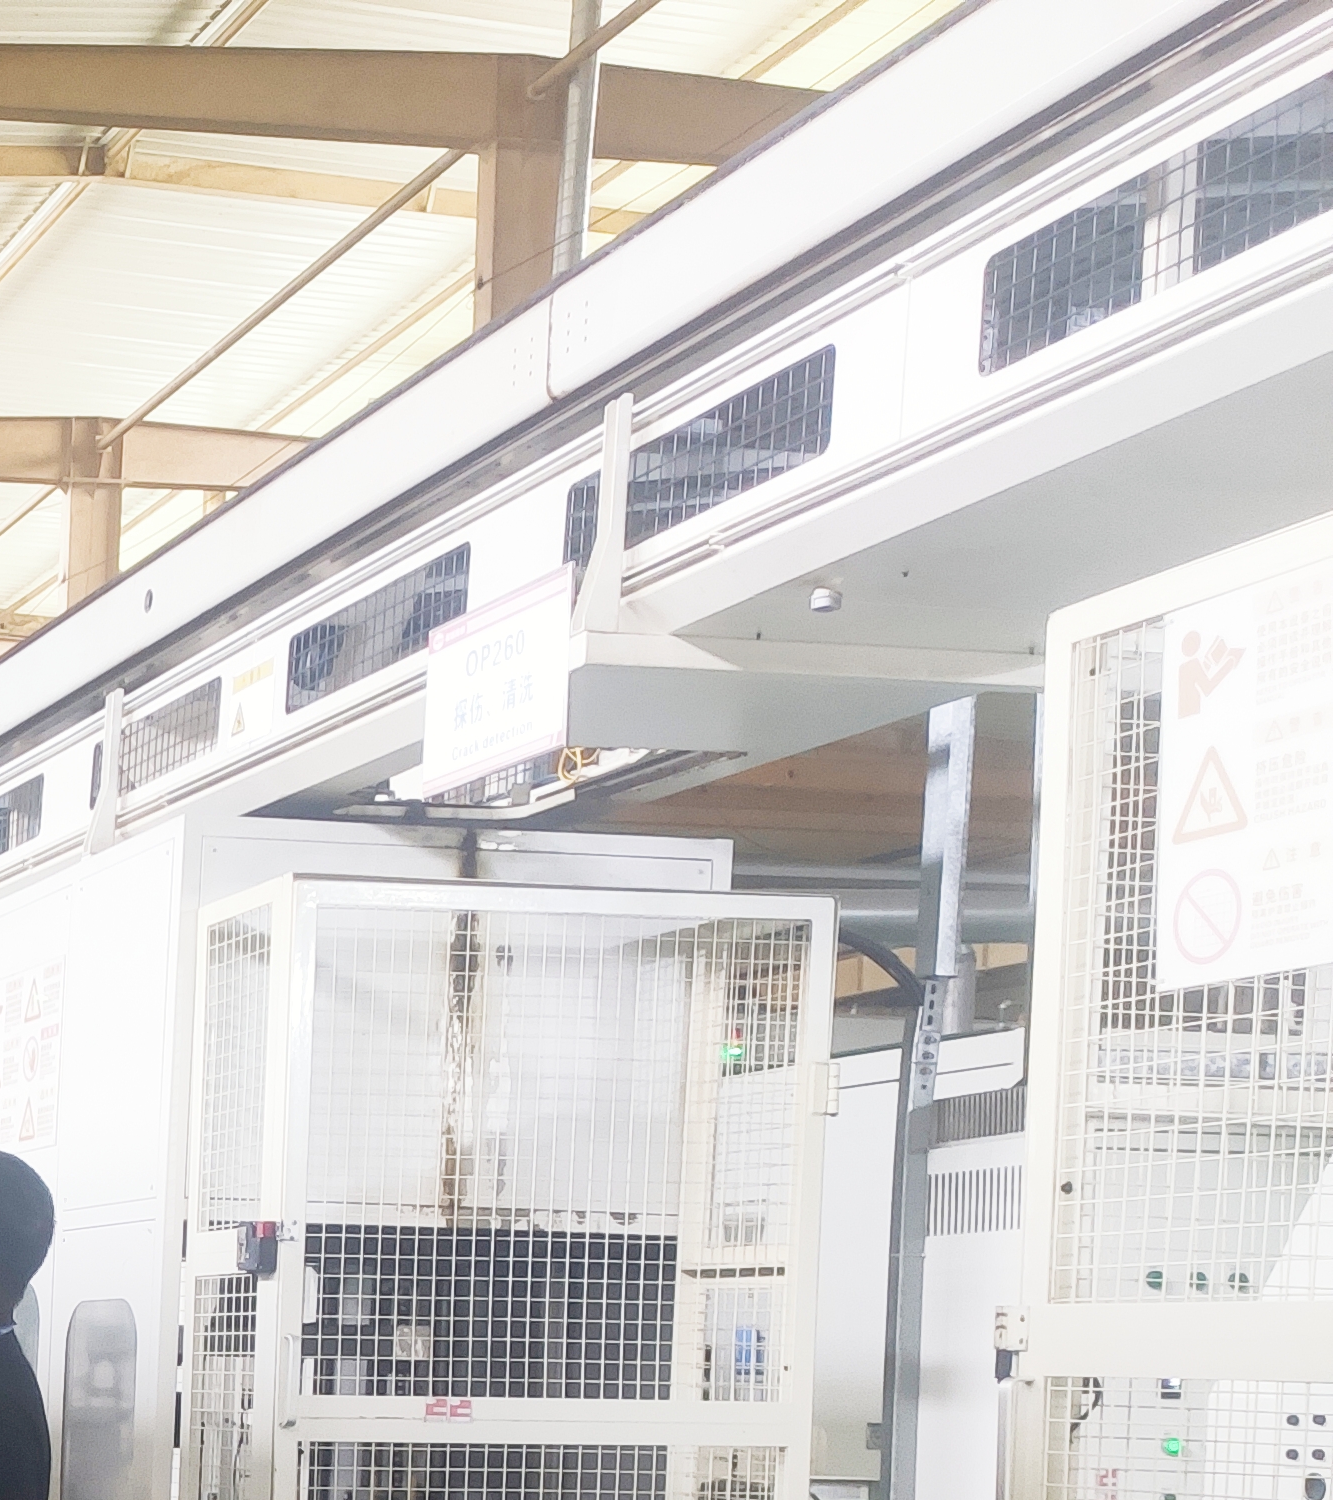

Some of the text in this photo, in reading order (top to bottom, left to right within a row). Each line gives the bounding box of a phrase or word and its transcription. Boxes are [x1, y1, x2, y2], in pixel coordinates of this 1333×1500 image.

[465, 629, 526, 677] OP260
[454, 672, 534, 732] 探伤、清洗
[451, 720, 533, 761] Crack detection
[1287, 798, 1327, 817] HAZARD
